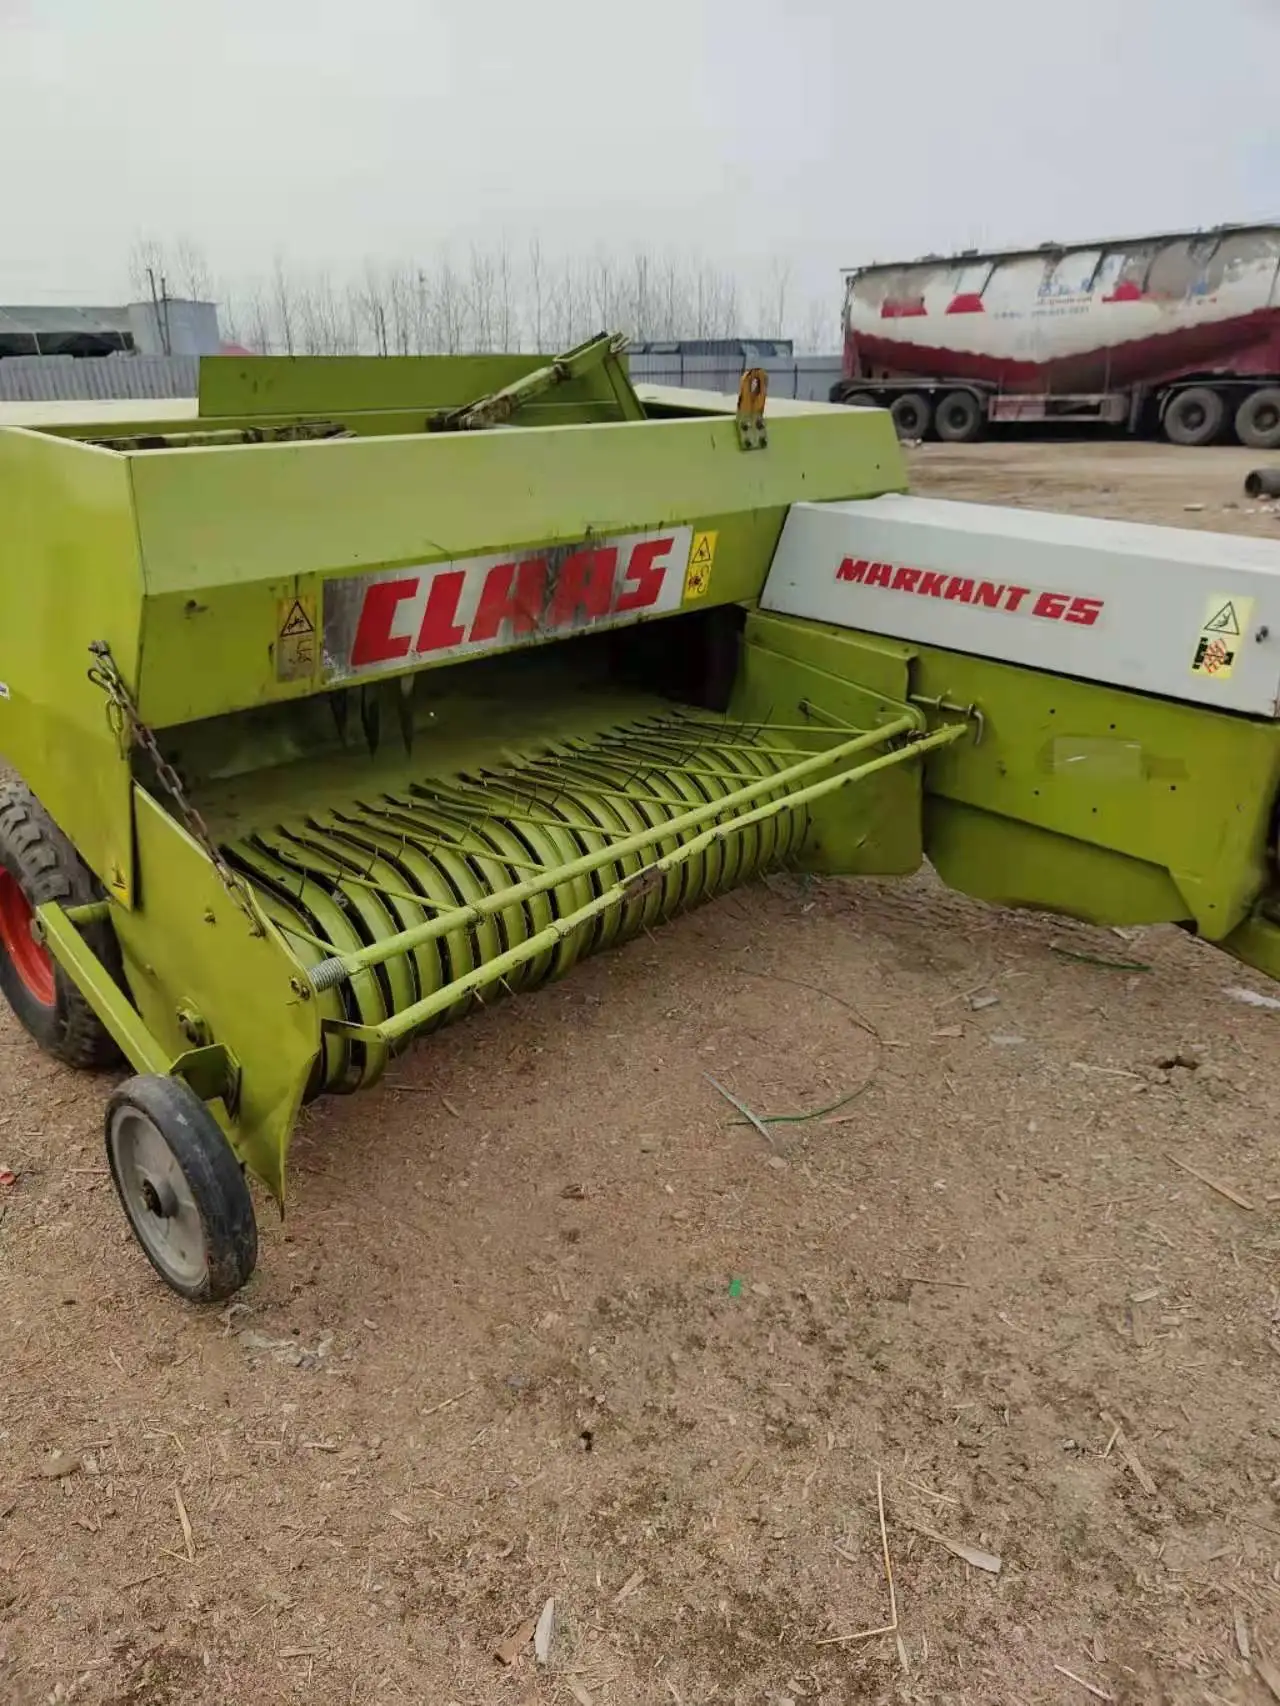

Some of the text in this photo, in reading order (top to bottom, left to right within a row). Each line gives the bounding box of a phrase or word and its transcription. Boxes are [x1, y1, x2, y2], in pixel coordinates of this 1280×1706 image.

[352, 538, 673, 667] CLAAS
[836, 558, 1104, 625] MARKANT 65
